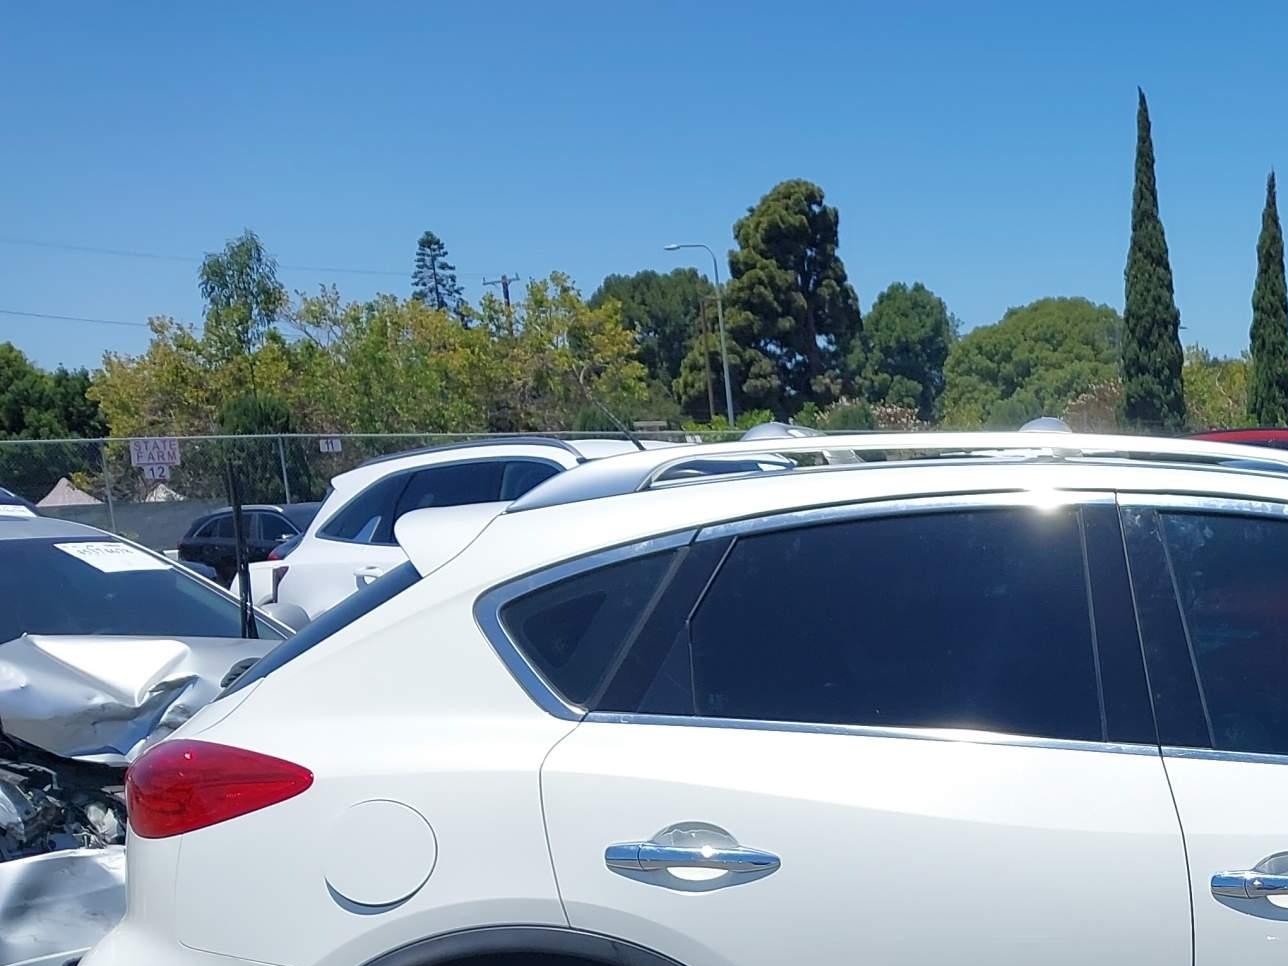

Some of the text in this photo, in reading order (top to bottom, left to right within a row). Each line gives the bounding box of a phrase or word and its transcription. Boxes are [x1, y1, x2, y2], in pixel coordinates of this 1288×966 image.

[133, 440, 177, 450] STATE
[325, 440, 335, 450] 11
[136, 450, 177, 461] FARM
[149, 465, 166, 479] 12
